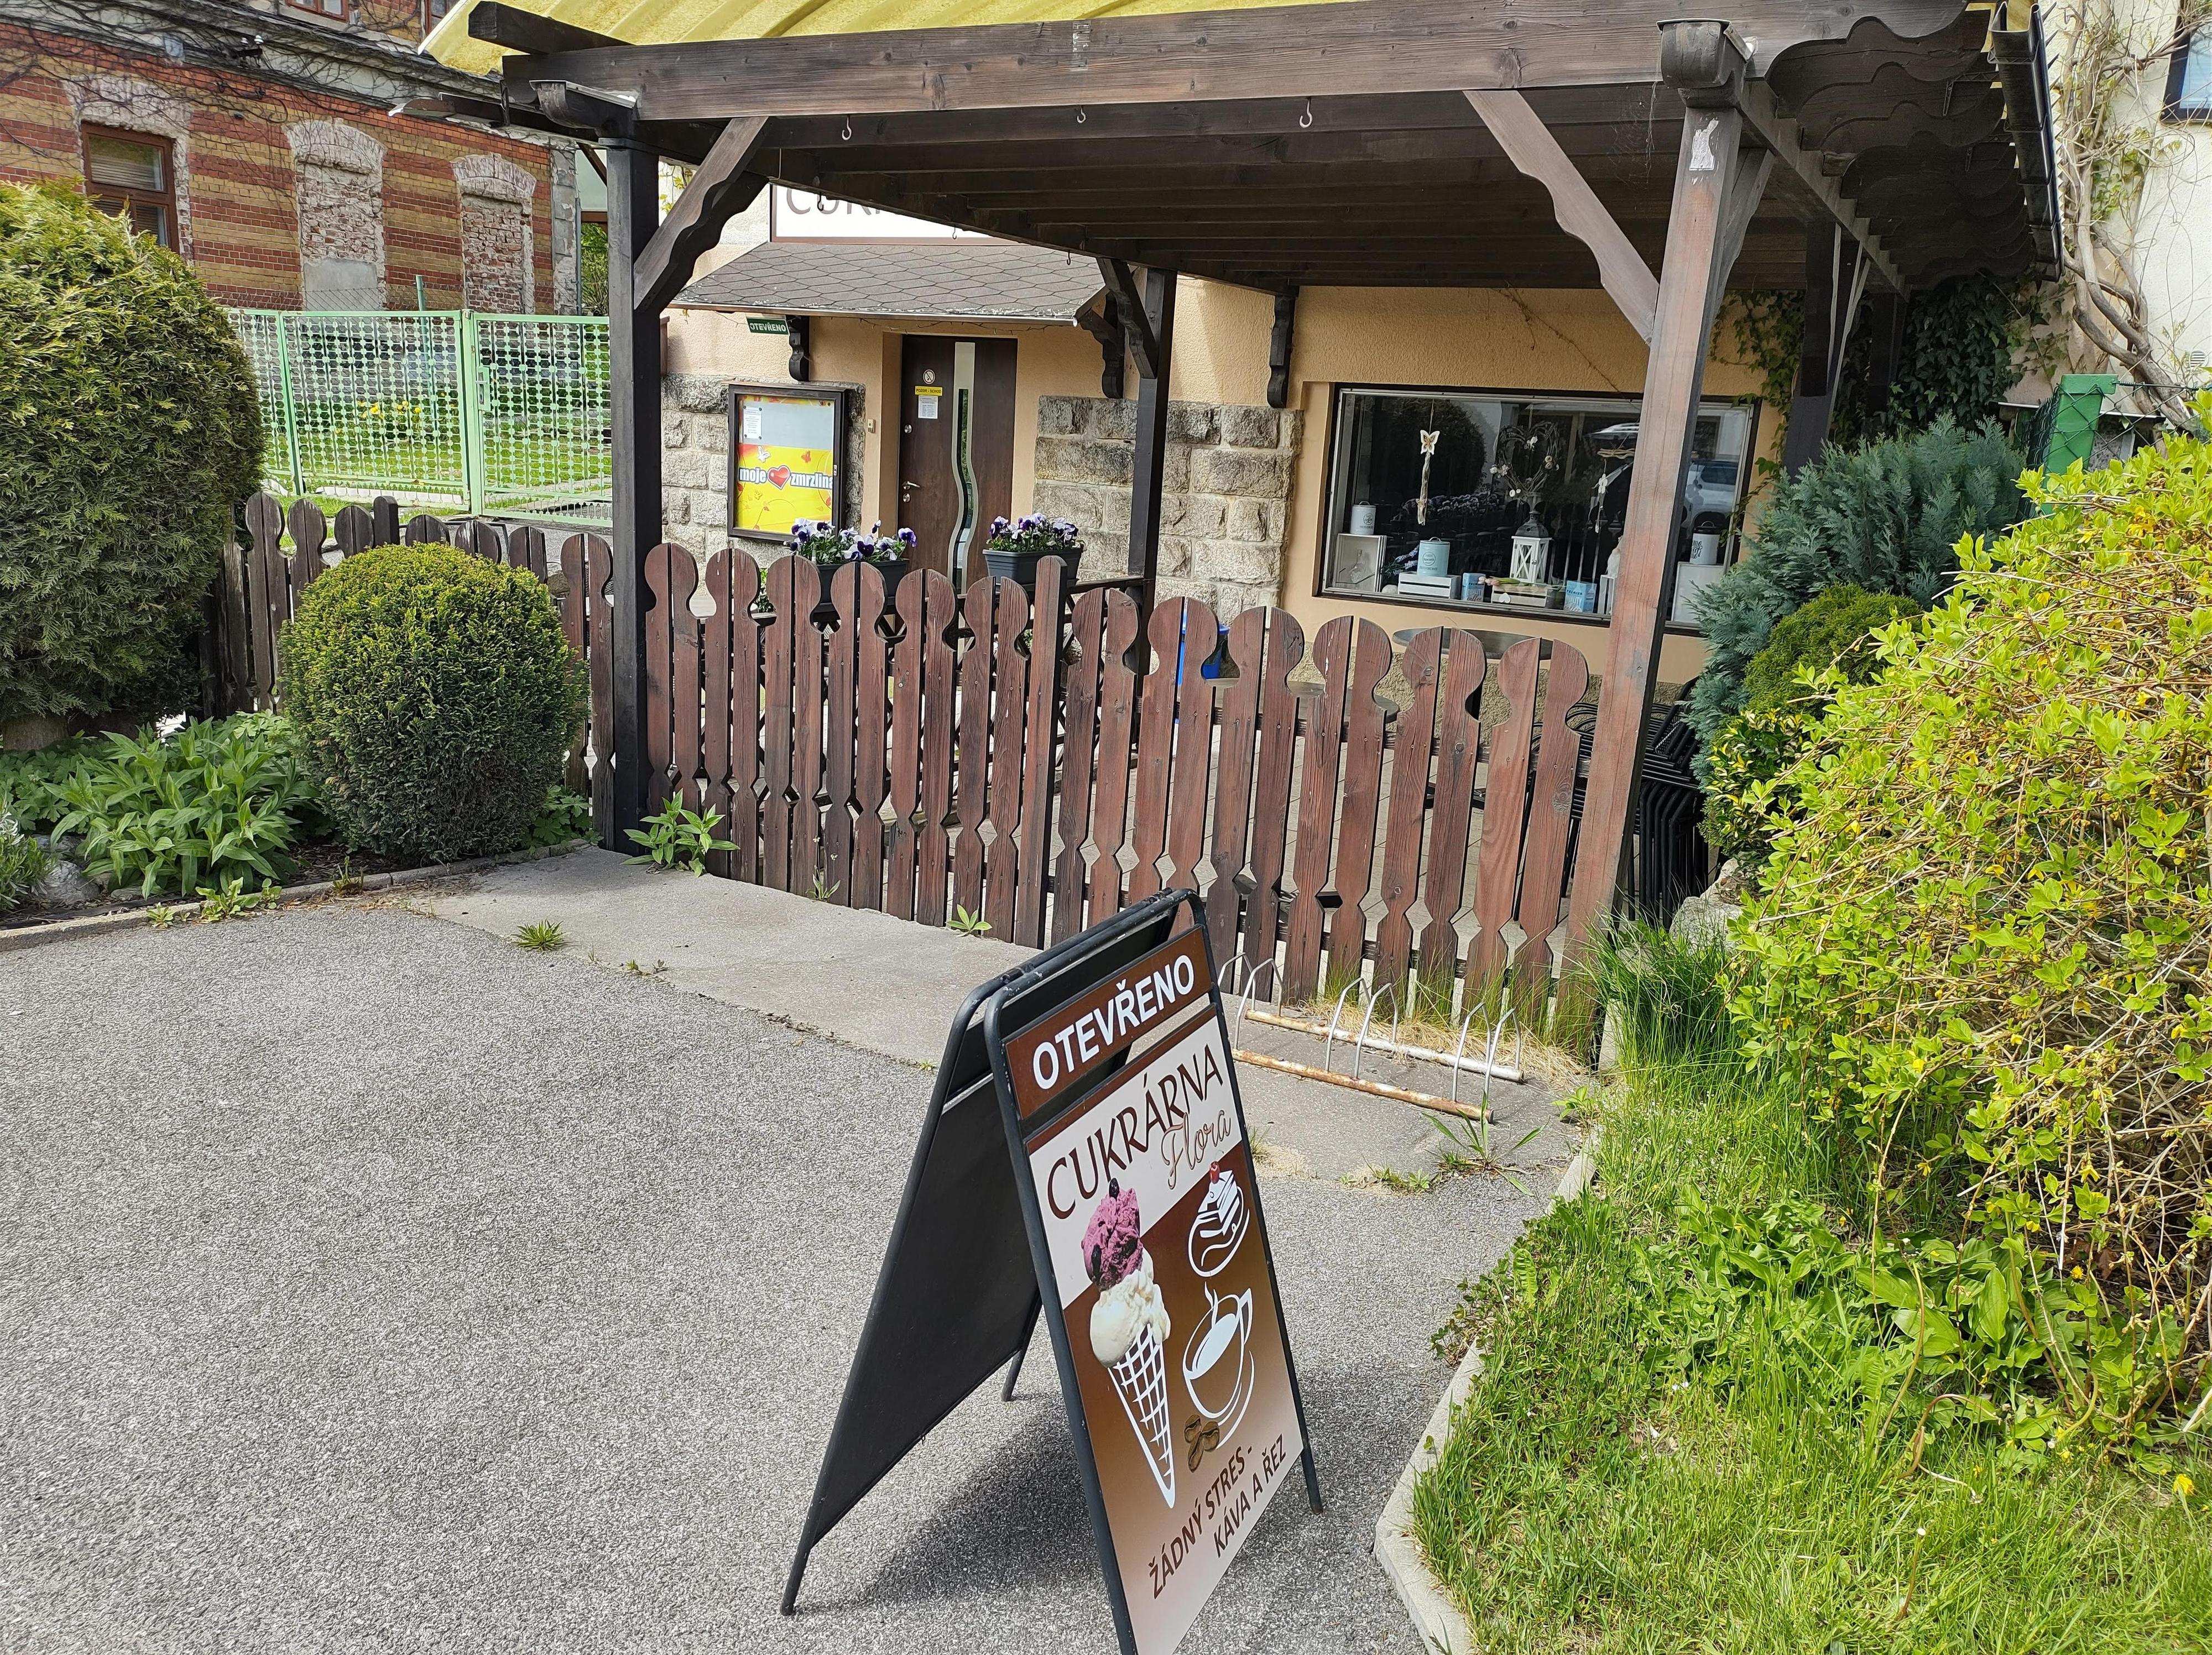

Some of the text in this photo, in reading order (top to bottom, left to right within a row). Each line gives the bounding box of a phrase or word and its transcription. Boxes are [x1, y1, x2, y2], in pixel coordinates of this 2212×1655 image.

[749, 322, 786, 332] OTEVŘENO
[739, 468, 767, 484] moje
[1032, 954, 1194, 1090] OTEVŘENO
[1047, 1044, 1223, 1220] CUKRÁRNA
[1161, 1110, 1231, 1190] Flora
[1148, 1497, 1203, 1600] ŽÁDNÝ
[1205, 1446, 1245, 1520] STRES
[1213, 1433, 1286, 1558] KÁVA A ŘEZ
